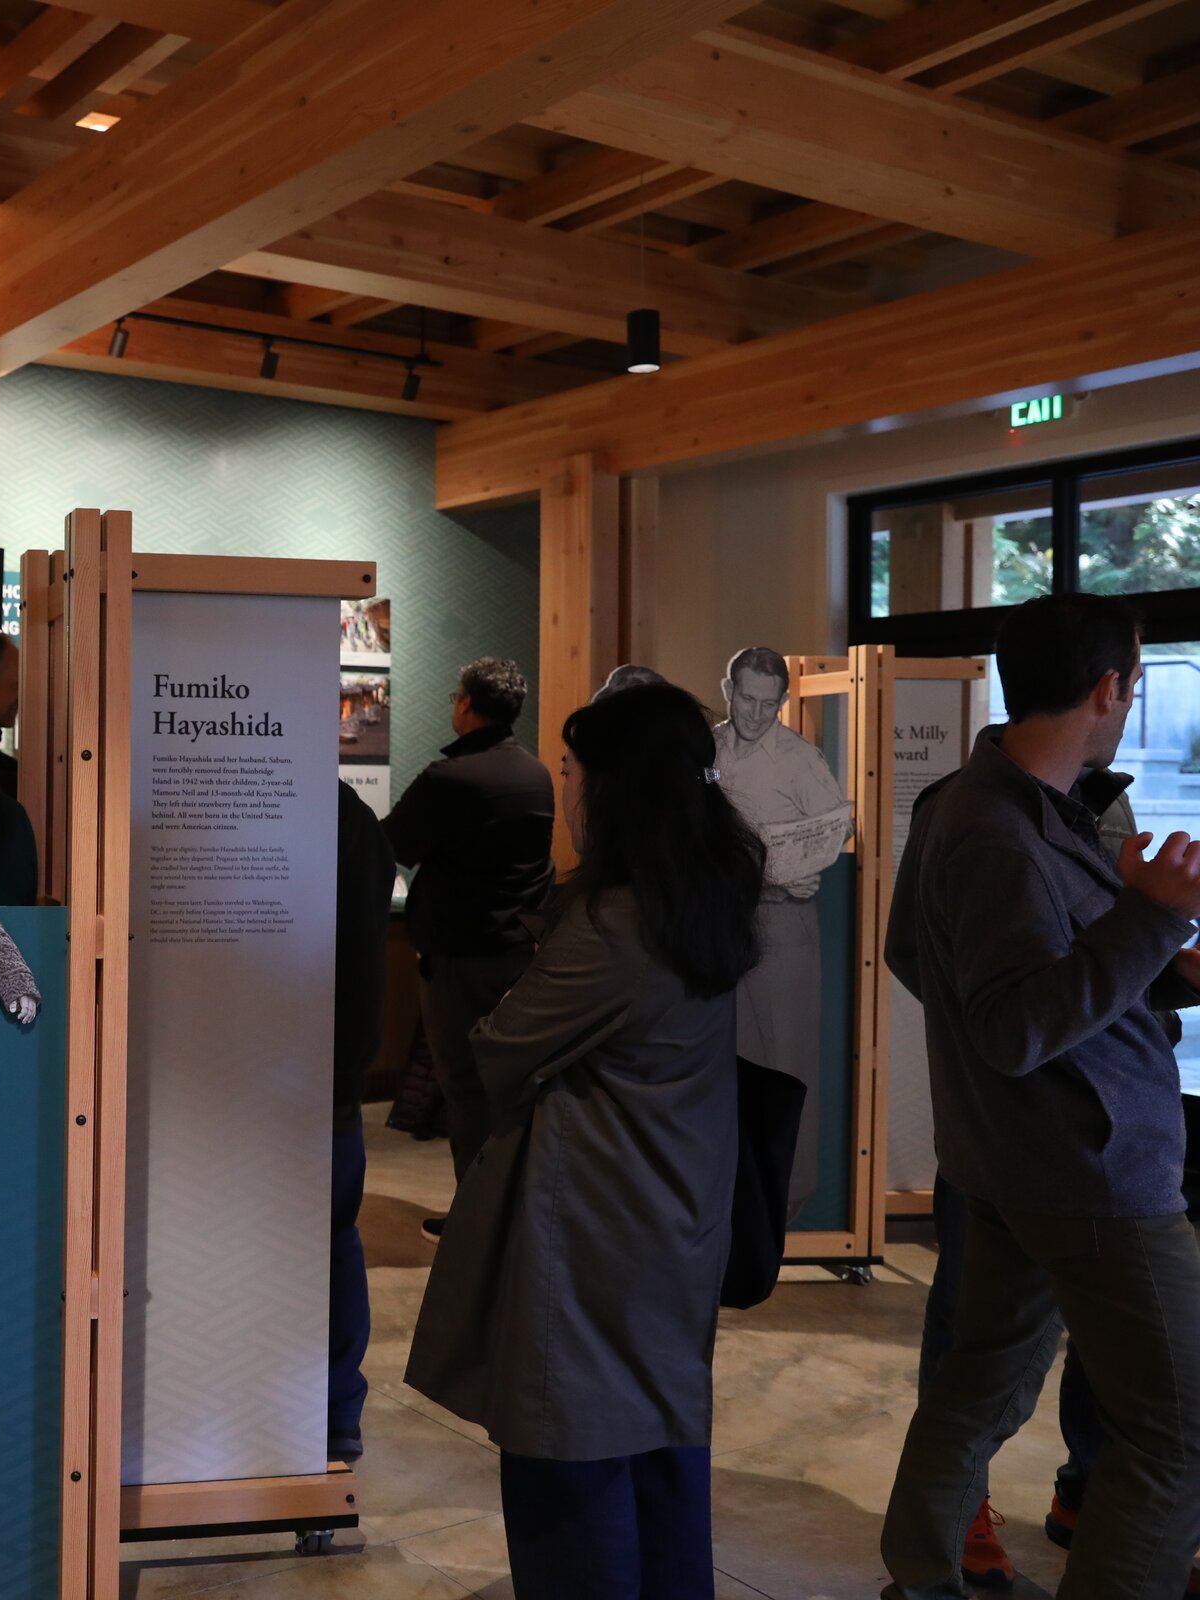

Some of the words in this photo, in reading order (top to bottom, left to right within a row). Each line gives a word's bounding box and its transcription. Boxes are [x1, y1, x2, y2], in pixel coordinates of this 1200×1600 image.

[153, 674, 250, 699] Fumiko
[153, 710, 283, 743] Hayashida
[909, 725, 949, 744] Milly
[179, 756, 212, 764] Hayashida
[240, 768, 274, 776] Bainbridge
[261, 779, 293, 788] 2-year-old
[256, 791, 272, 799] Kayo
[152, 801, 167, 809] They
[198, 801, 231, 809] strawberry
